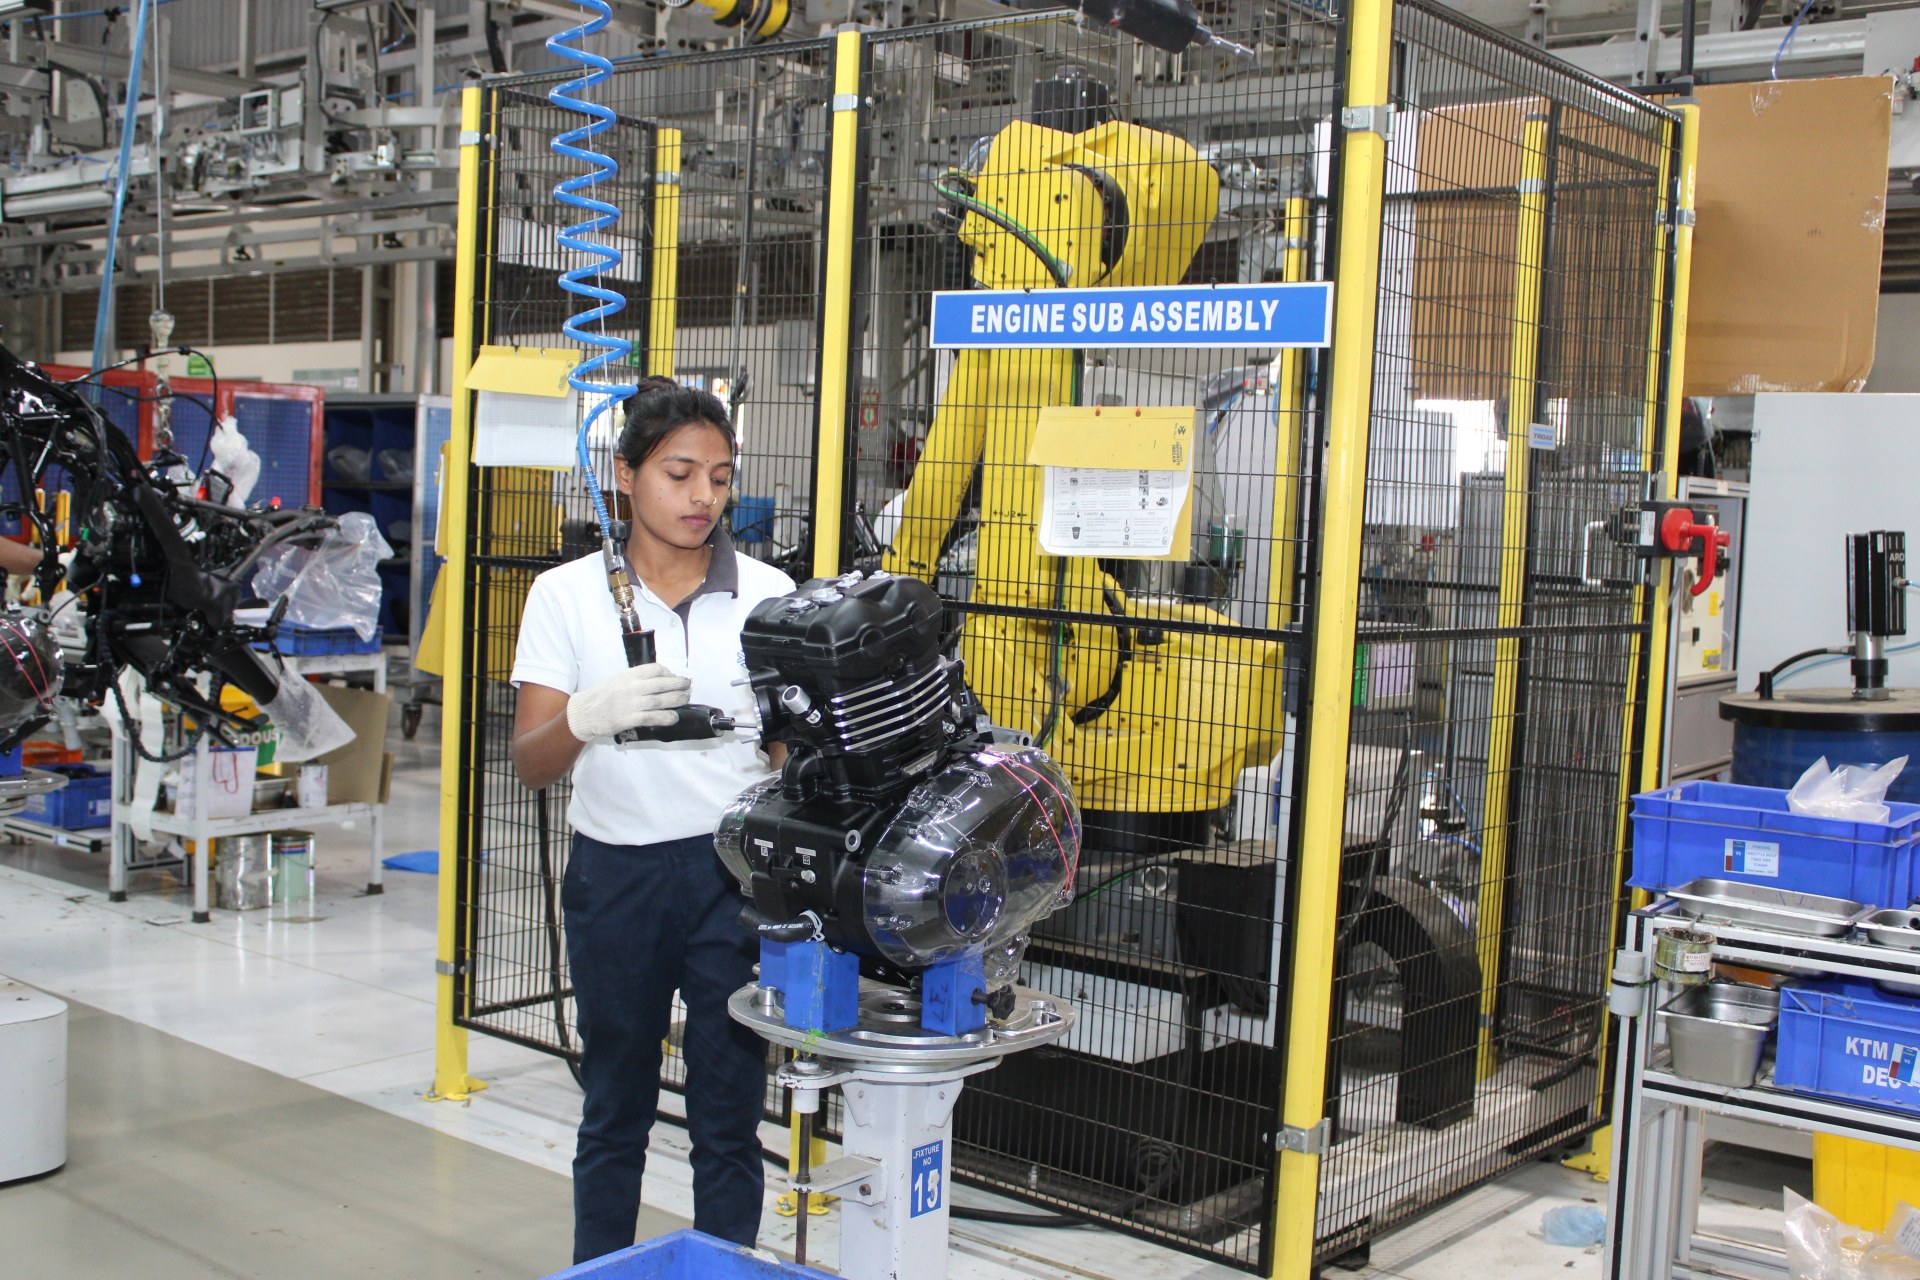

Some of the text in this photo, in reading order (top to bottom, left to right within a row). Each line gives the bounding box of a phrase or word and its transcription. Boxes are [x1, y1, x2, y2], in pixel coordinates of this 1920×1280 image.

[971, 299, 1280, 333] ENGINE SUB ASSEMBLY
[1890, 552, 1904, 562] ARO
[1846, 1036, 1888, 1060] KTM
[915, 1144, 940, 1158] FIXTURE
[922, 1158, 932, 1166] NO
